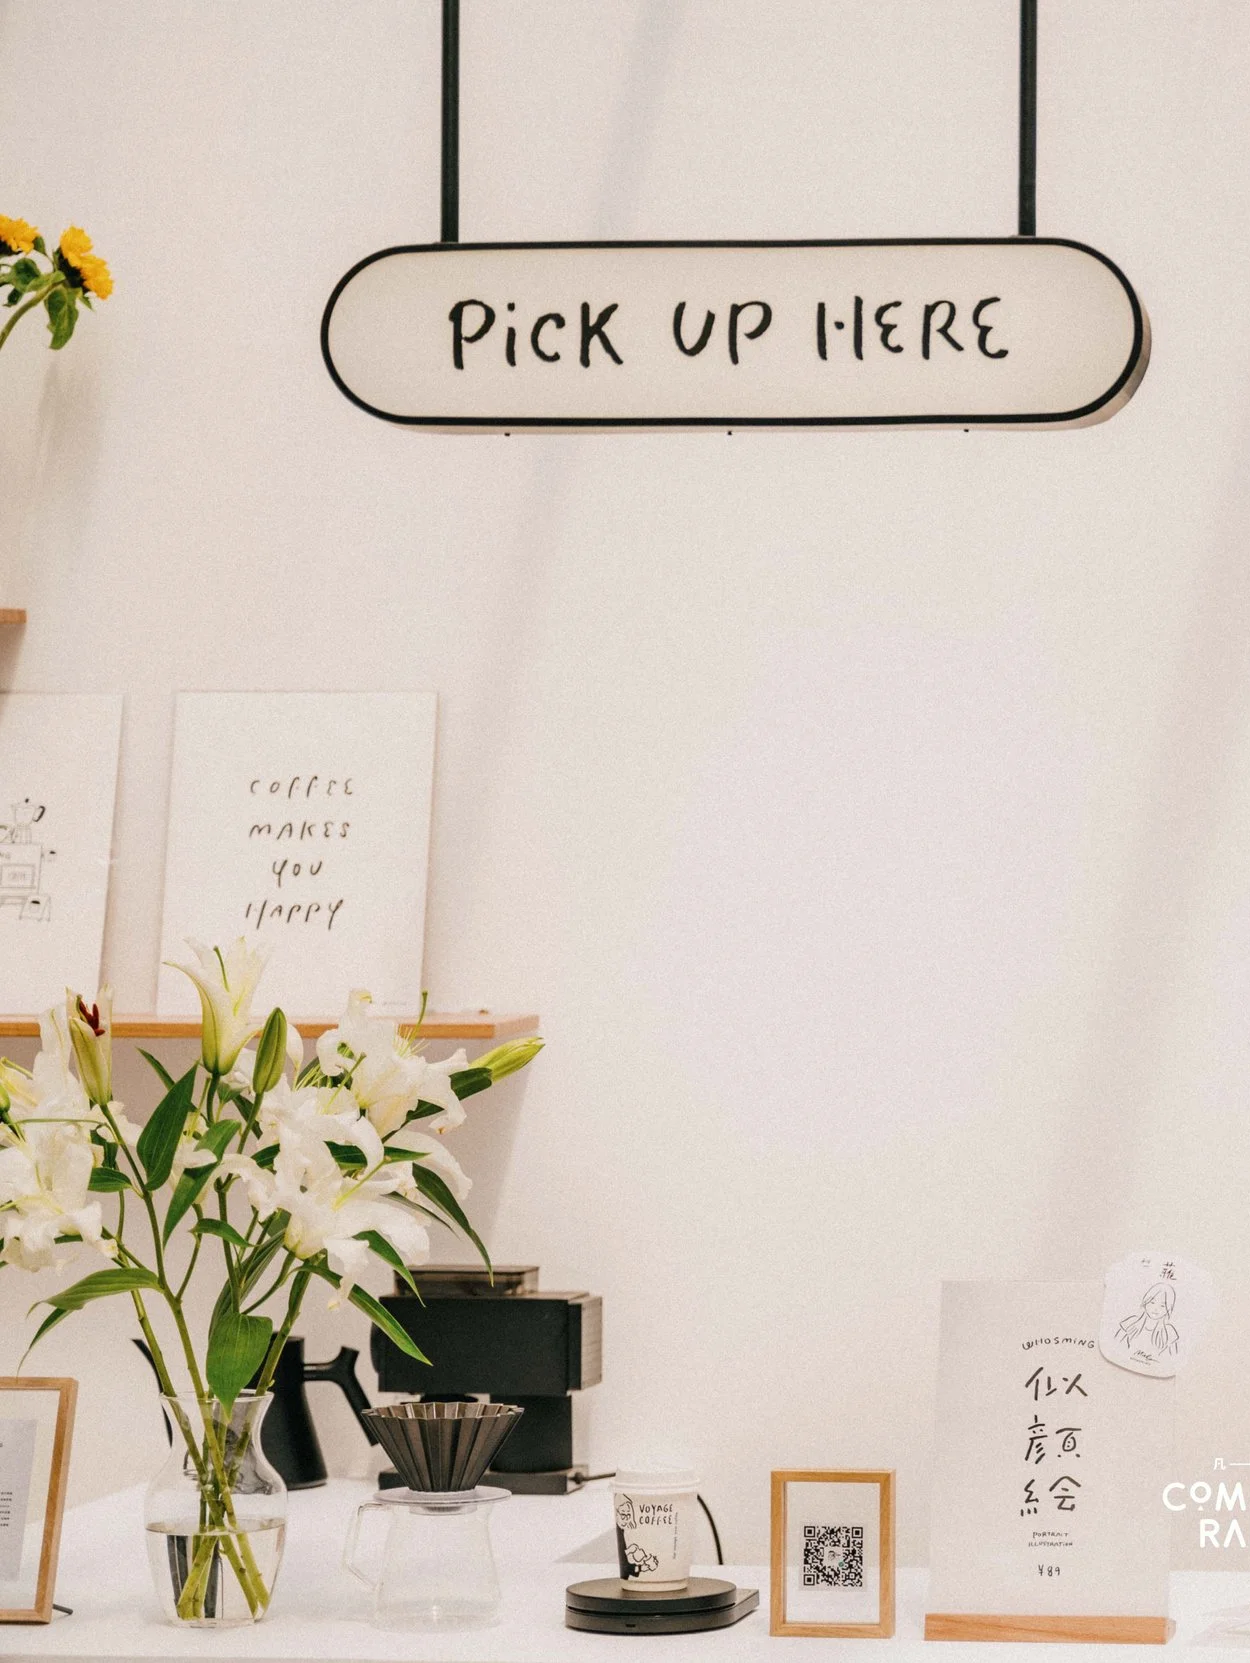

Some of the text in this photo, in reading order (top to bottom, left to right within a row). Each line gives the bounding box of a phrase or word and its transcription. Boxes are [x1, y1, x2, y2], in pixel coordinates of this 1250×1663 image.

[672, 301, 773, 366] UP
[816, 295, 1010, 362] HERE
[248, 821, 351, 841] MAKES
[271, 858, 323, 888] YOU
[245, 898, 344, 931] HAPPY
[639, 1503, 673, 1515] VOYAGE
[639, 1515, 673, 1526] COFFEE
